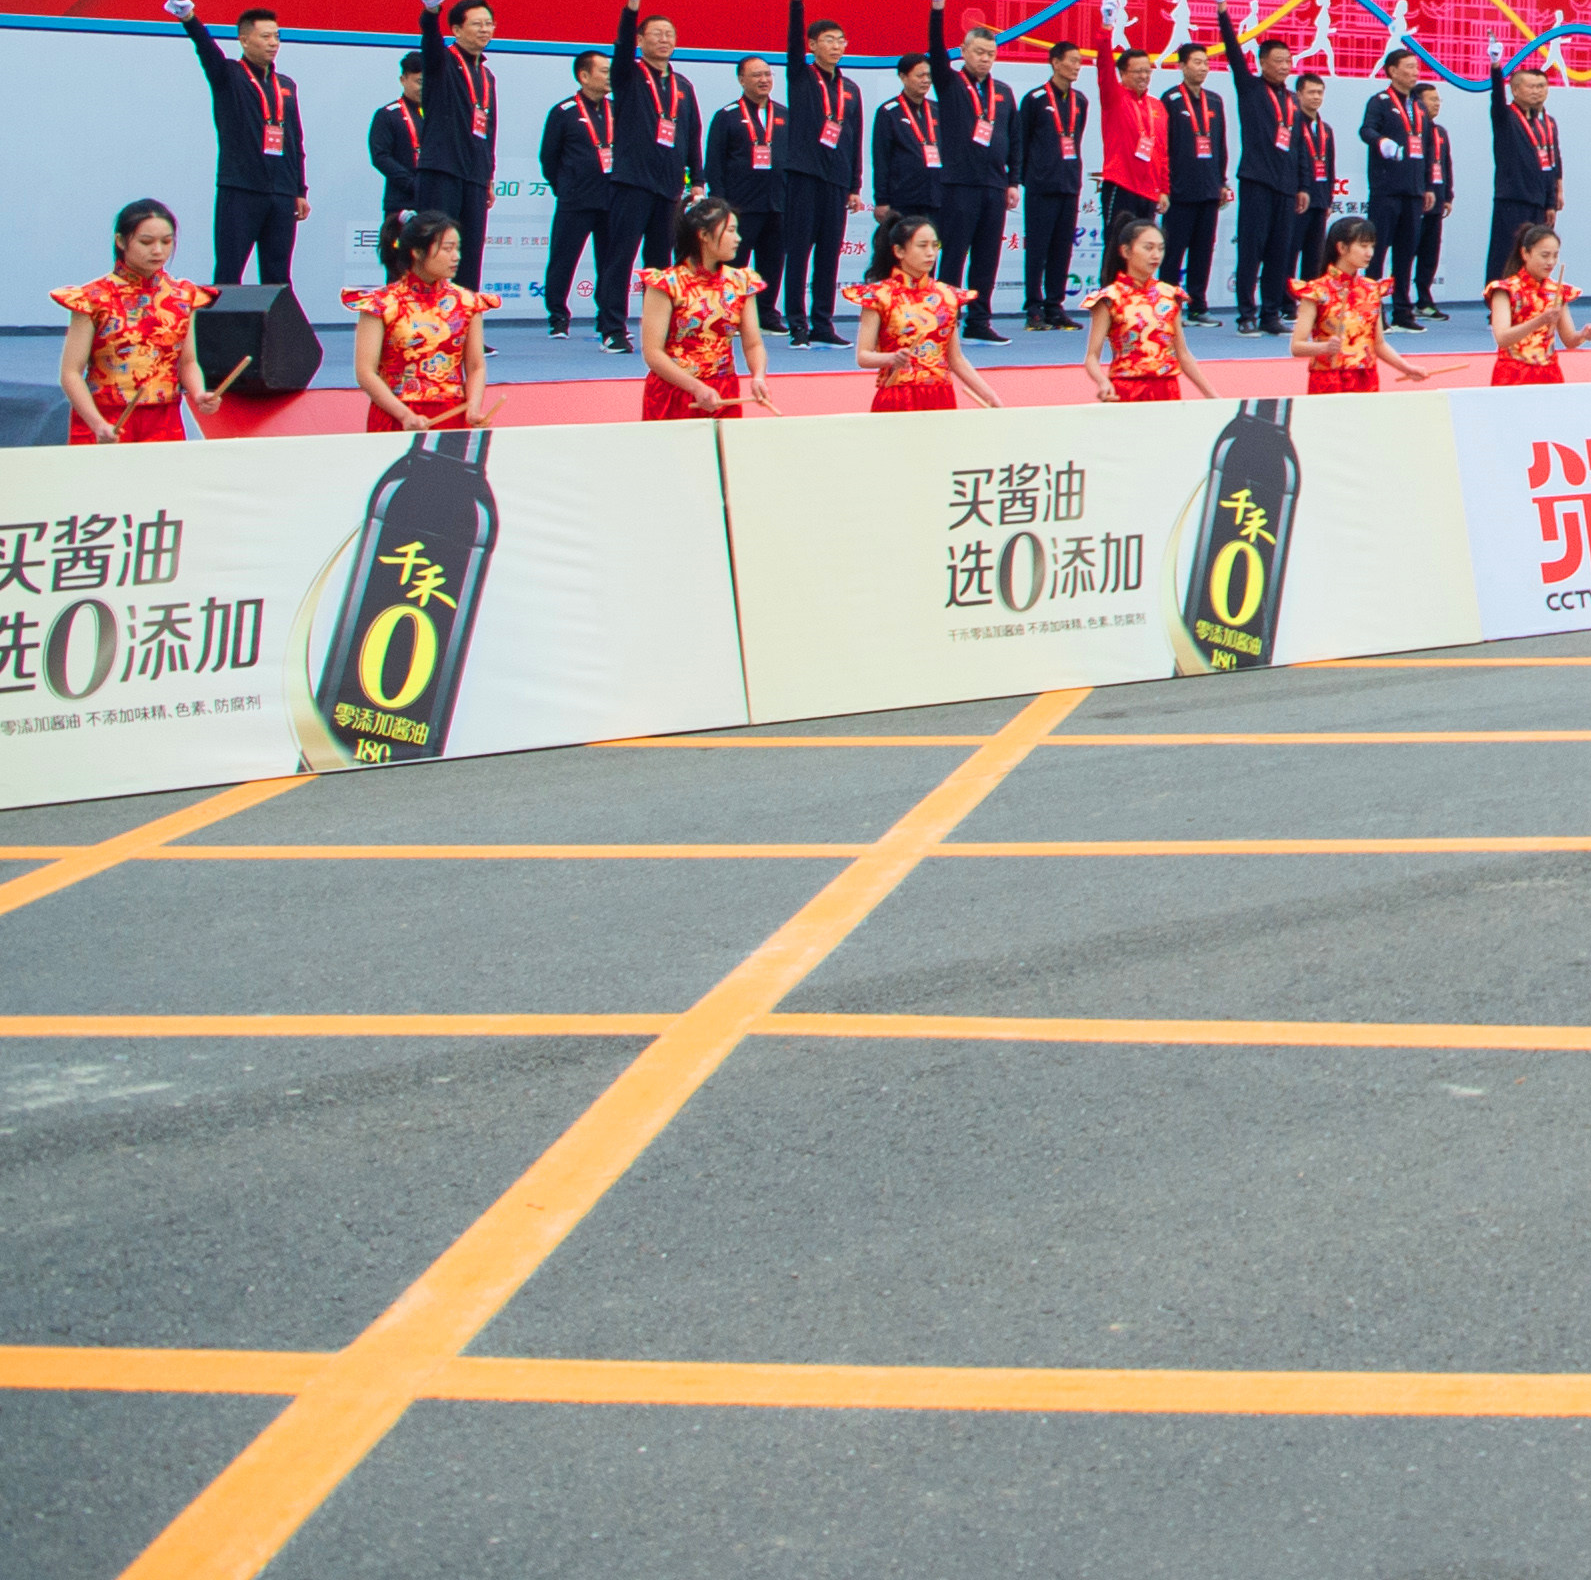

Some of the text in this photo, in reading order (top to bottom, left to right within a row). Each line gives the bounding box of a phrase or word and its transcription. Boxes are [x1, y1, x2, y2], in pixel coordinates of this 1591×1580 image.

[948, 459, 1086, 531] 买酱油
[1219, 488, 1277, 545] 千禾
[0, 509, 184, 596] 买酱油
[378, 540, 458, 610] 千禾
[945, 529, 1145, 613] 选0添加
